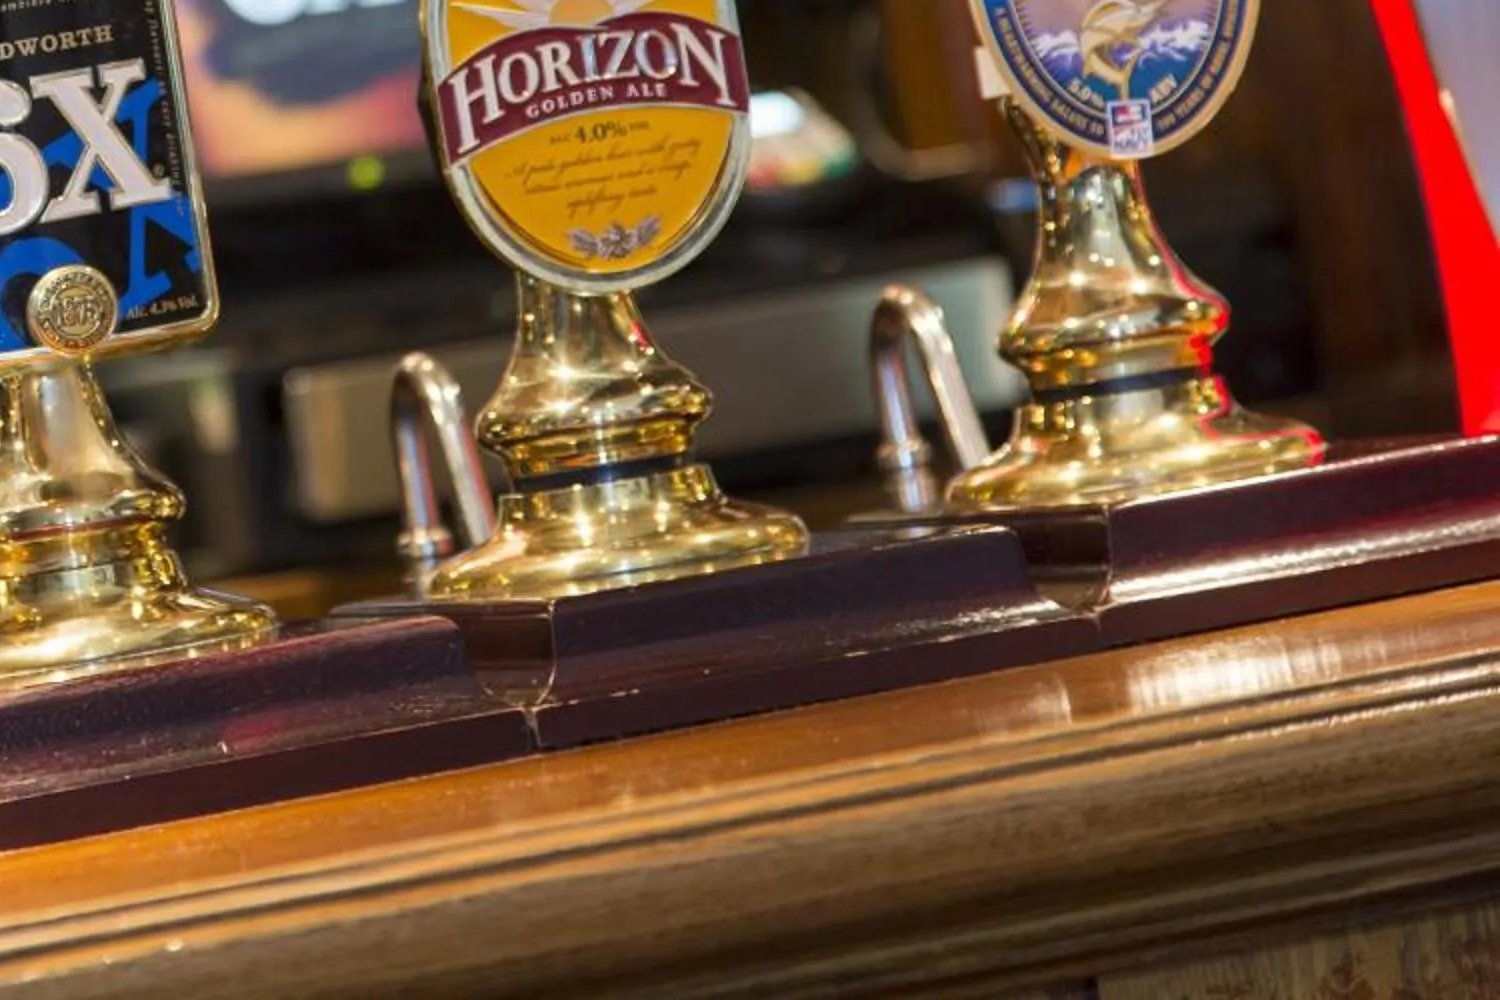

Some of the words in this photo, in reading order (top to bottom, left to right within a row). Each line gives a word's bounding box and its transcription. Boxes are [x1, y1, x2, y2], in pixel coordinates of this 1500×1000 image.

[450, 24, 739, 154] HORIZON
[527, 85, 614, 119] GOLDEN
[627, 82, 667, 98] ALE
[574, 121, 628, 144] 4.0%
